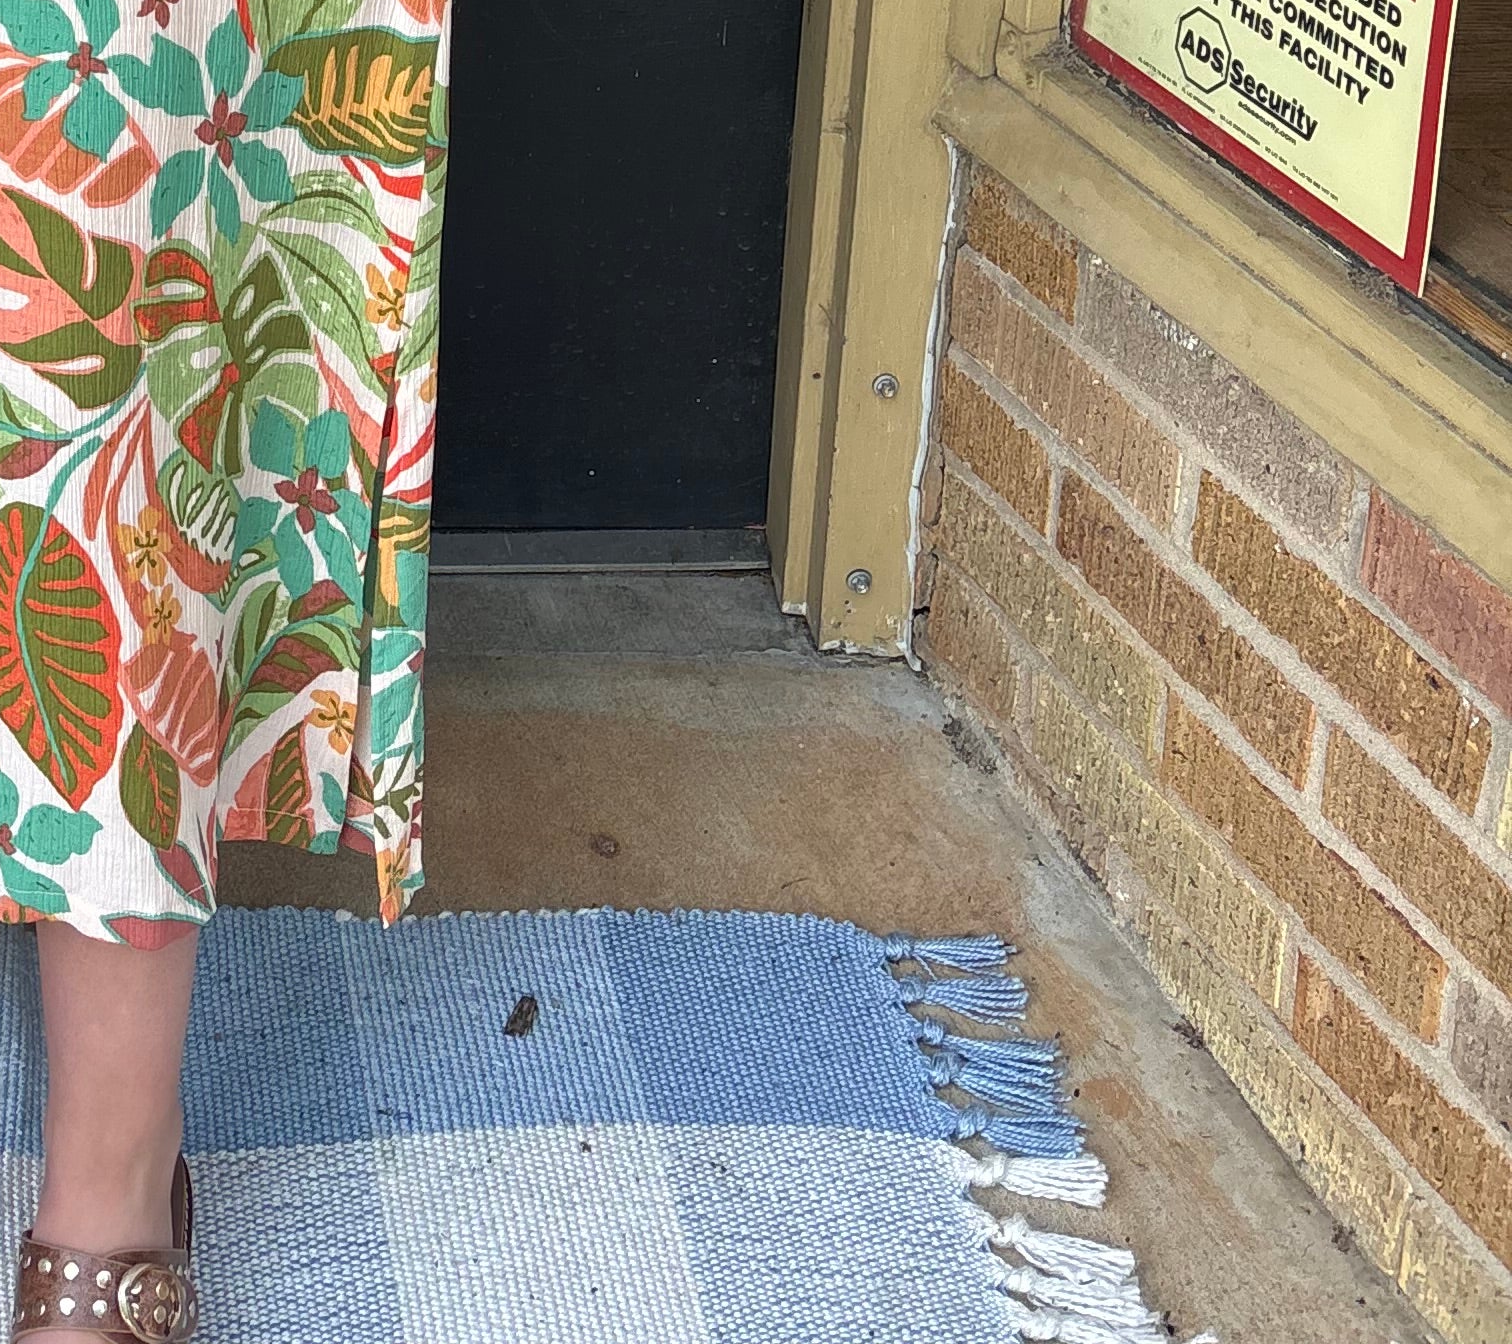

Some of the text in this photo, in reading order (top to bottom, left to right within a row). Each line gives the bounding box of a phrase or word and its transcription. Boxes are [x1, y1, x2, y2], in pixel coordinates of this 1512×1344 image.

[1180, 28, 1225, 75] ADS
[1229, 59, 1318, 141] Security
[1279, 28, 1370, 105] FACILITY
